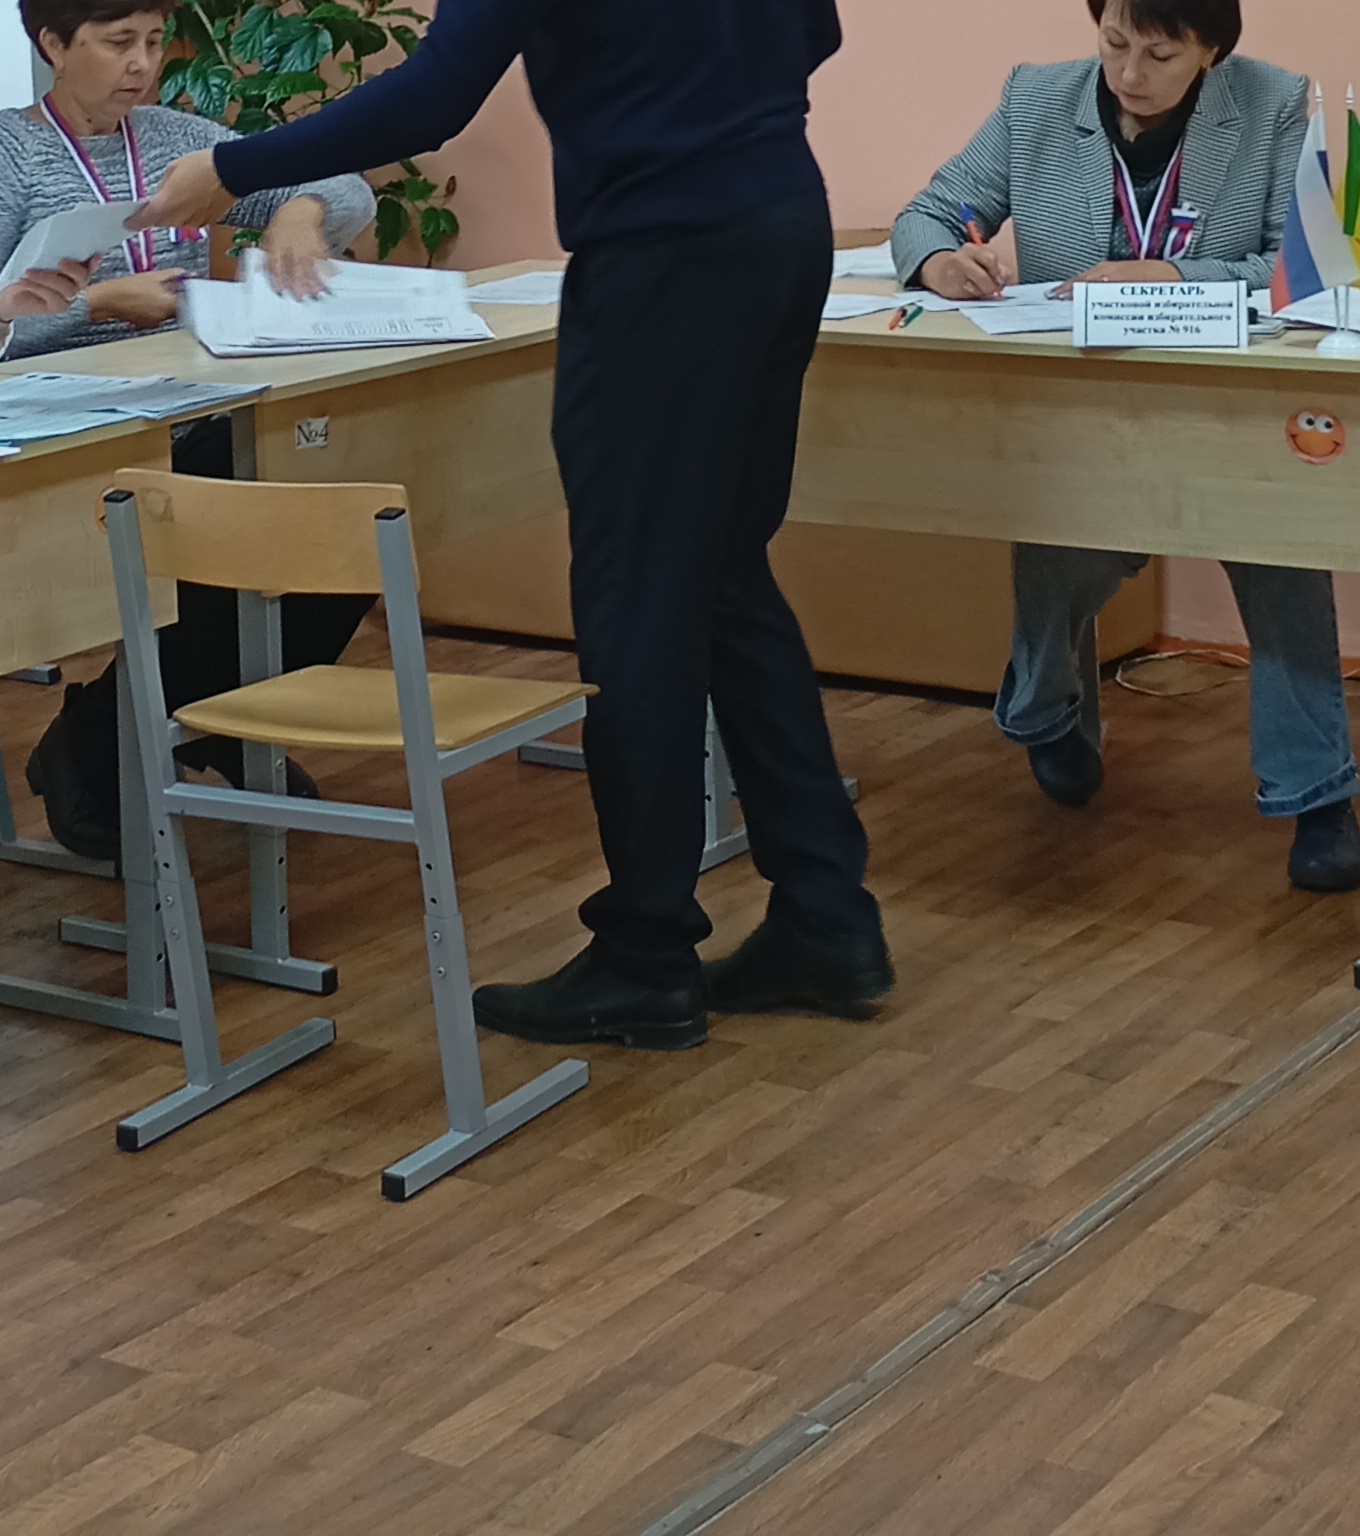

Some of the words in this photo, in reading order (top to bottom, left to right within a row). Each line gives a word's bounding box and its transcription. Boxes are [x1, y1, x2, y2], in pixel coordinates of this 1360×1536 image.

[1120, 286, 1205, 296] СЕКРЕТАРЬ
[1090, 300, 1151, 310] участковой
[1154, 299, 1234, 310] избирательной
[1093, 313, 1146, 321] комиссии
[1147, 312, 1232, 323] избирательного
[1123, 326, 1165, 335] участка
[1183, 325, 1201, 334] 916
